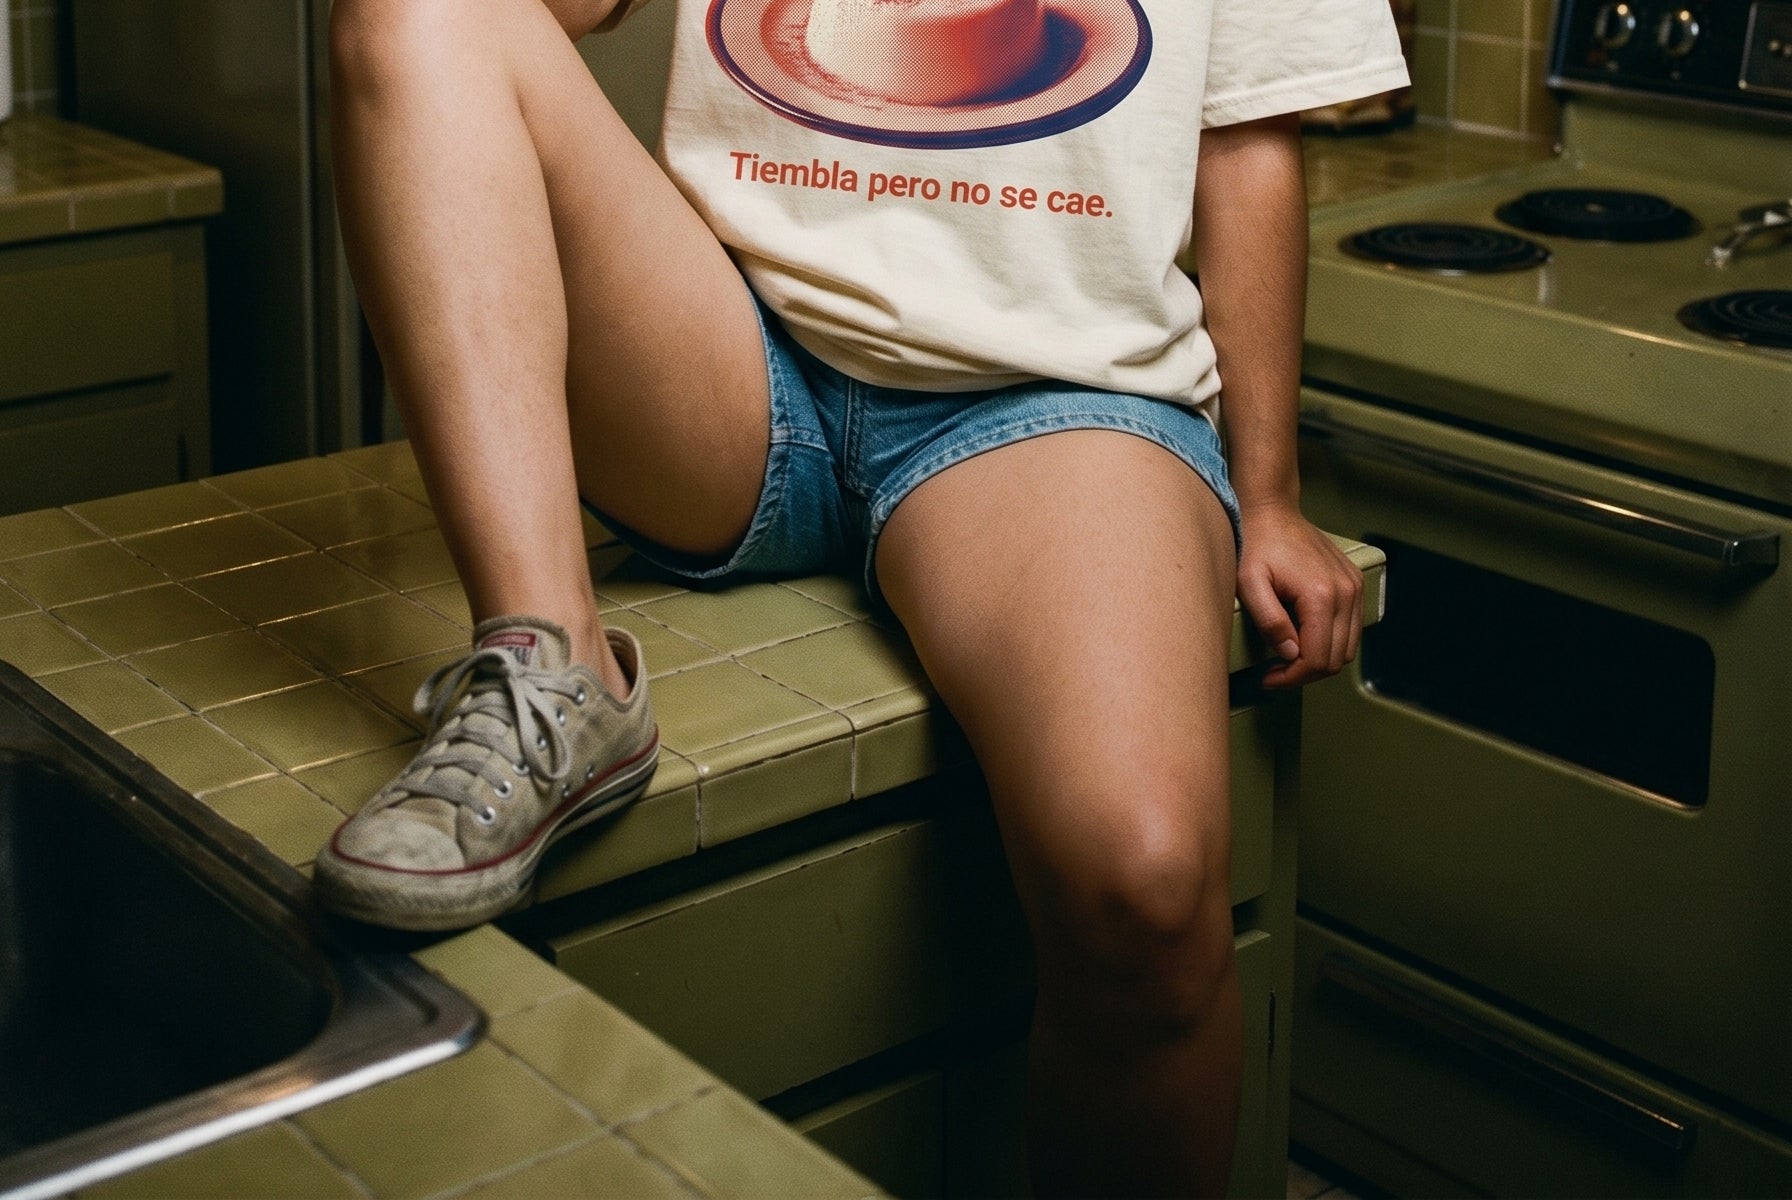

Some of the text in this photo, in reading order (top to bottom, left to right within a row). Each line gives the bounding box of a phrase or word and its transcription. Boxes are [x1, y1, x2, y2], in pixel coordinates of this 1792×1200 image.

[729, 150, 1114, 218] Tiembla pero no se cae.
